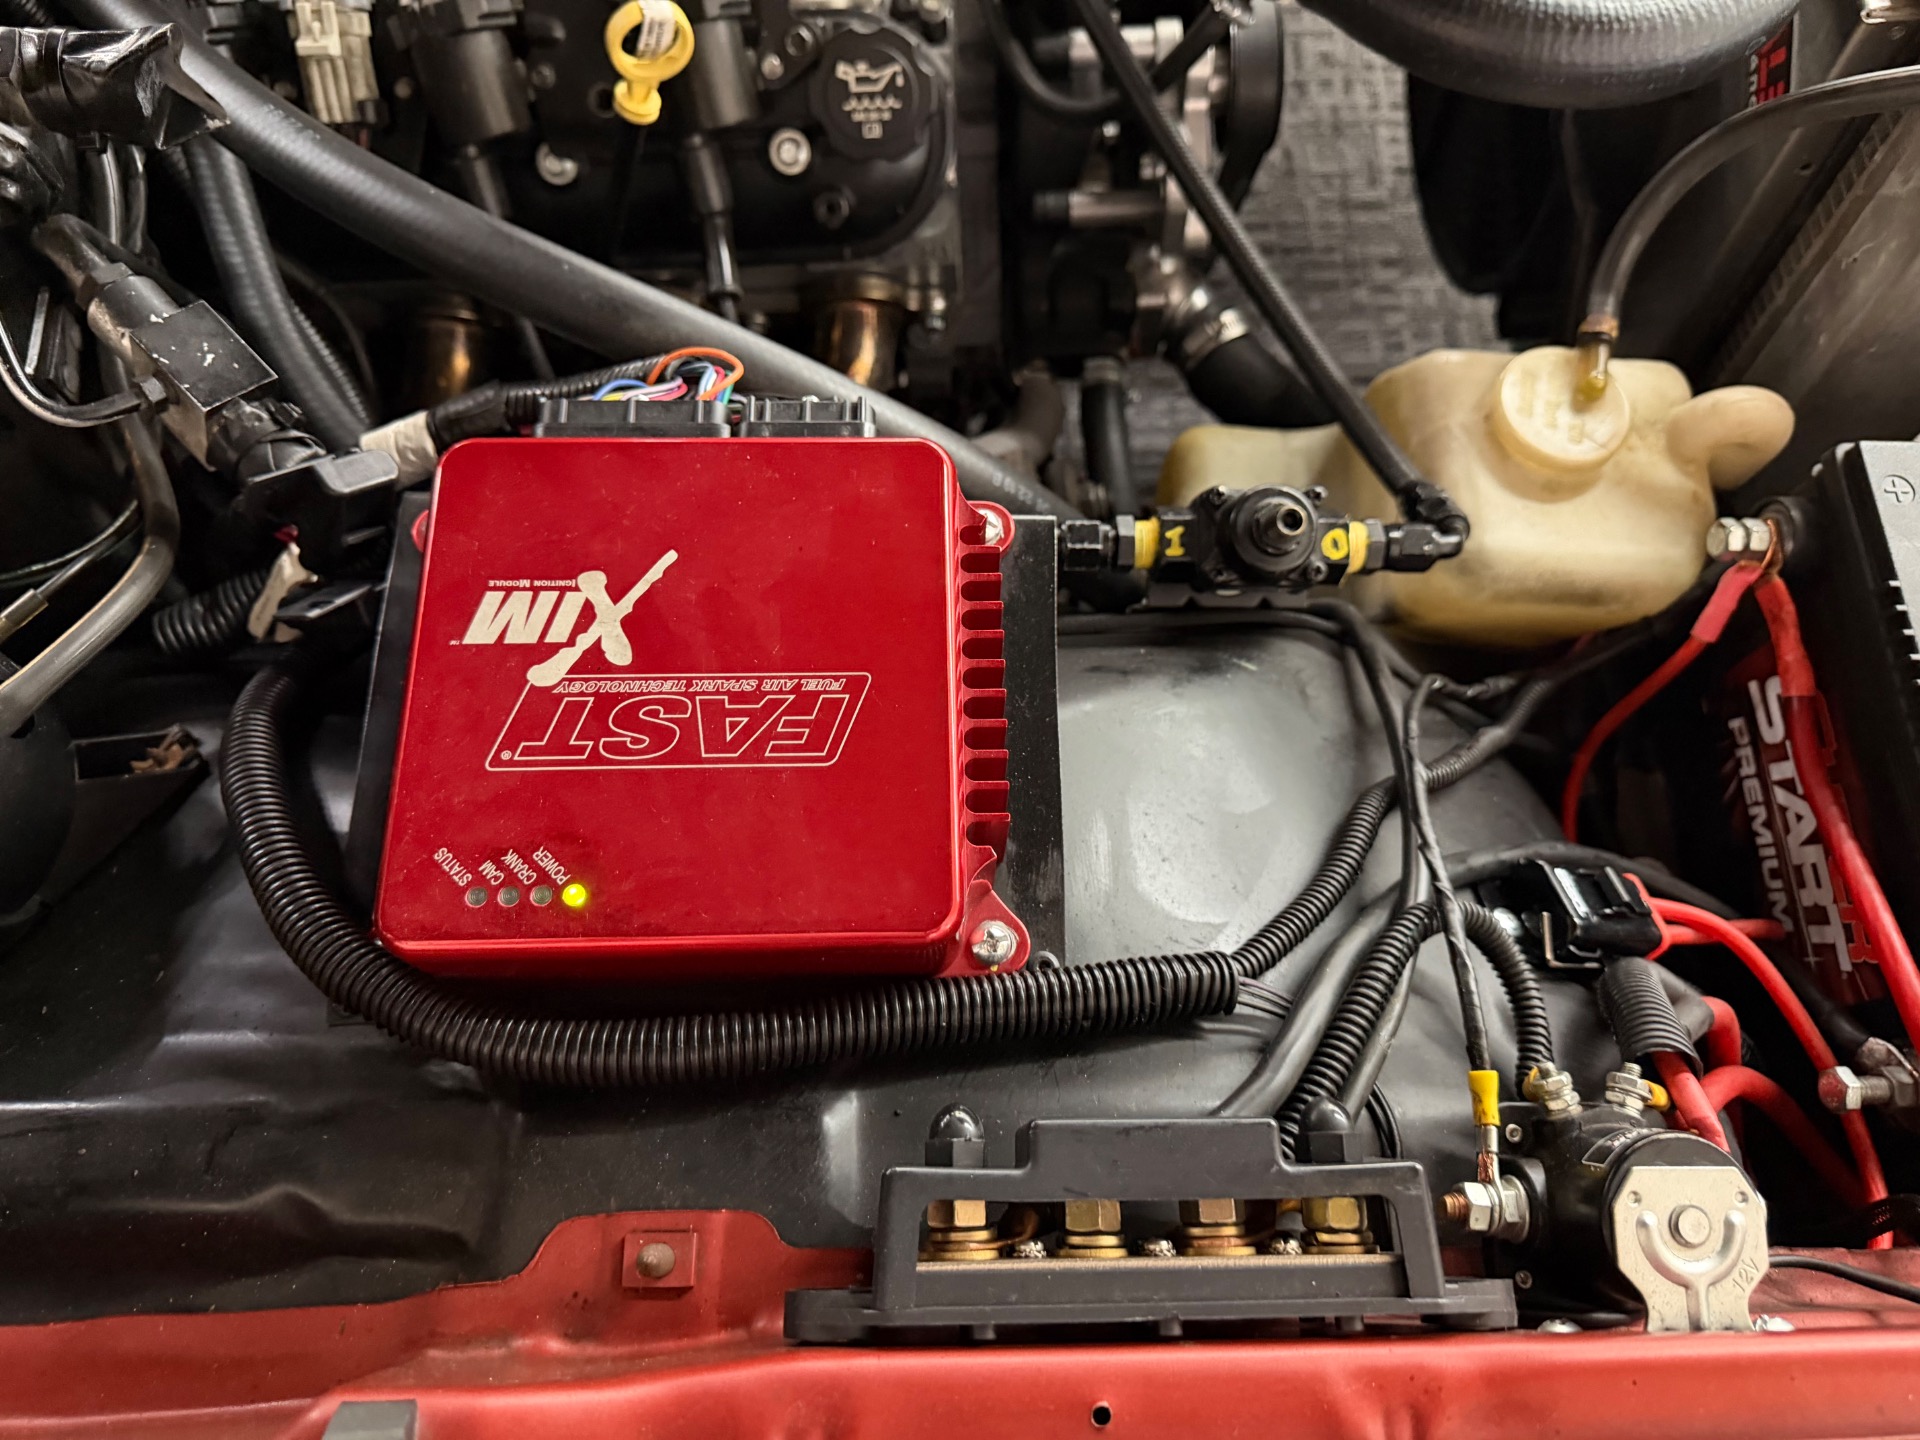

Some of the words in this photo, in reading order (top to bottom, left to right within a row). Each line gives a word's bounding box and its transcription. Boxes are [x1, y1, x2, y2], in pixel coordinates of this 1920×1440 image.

[552, 680, 686, 694] TECHNOLOGY
[689, 679, 758, 692] SPARK
[762, 678, 798, 691] AIR
[800, 678, 846, 691] FUEL
[1727, 715, 1795, 933] PREMIUM
[1748, 675, 1853, 972] START
[433, 847, 472, 886] STATUS
[478, 859, 505, 885] CAM
[500, 848, 537, 885] CRANK
[532, 846, 571, 885] POWER
[1732, 1256, 1760, 1294] 12V
